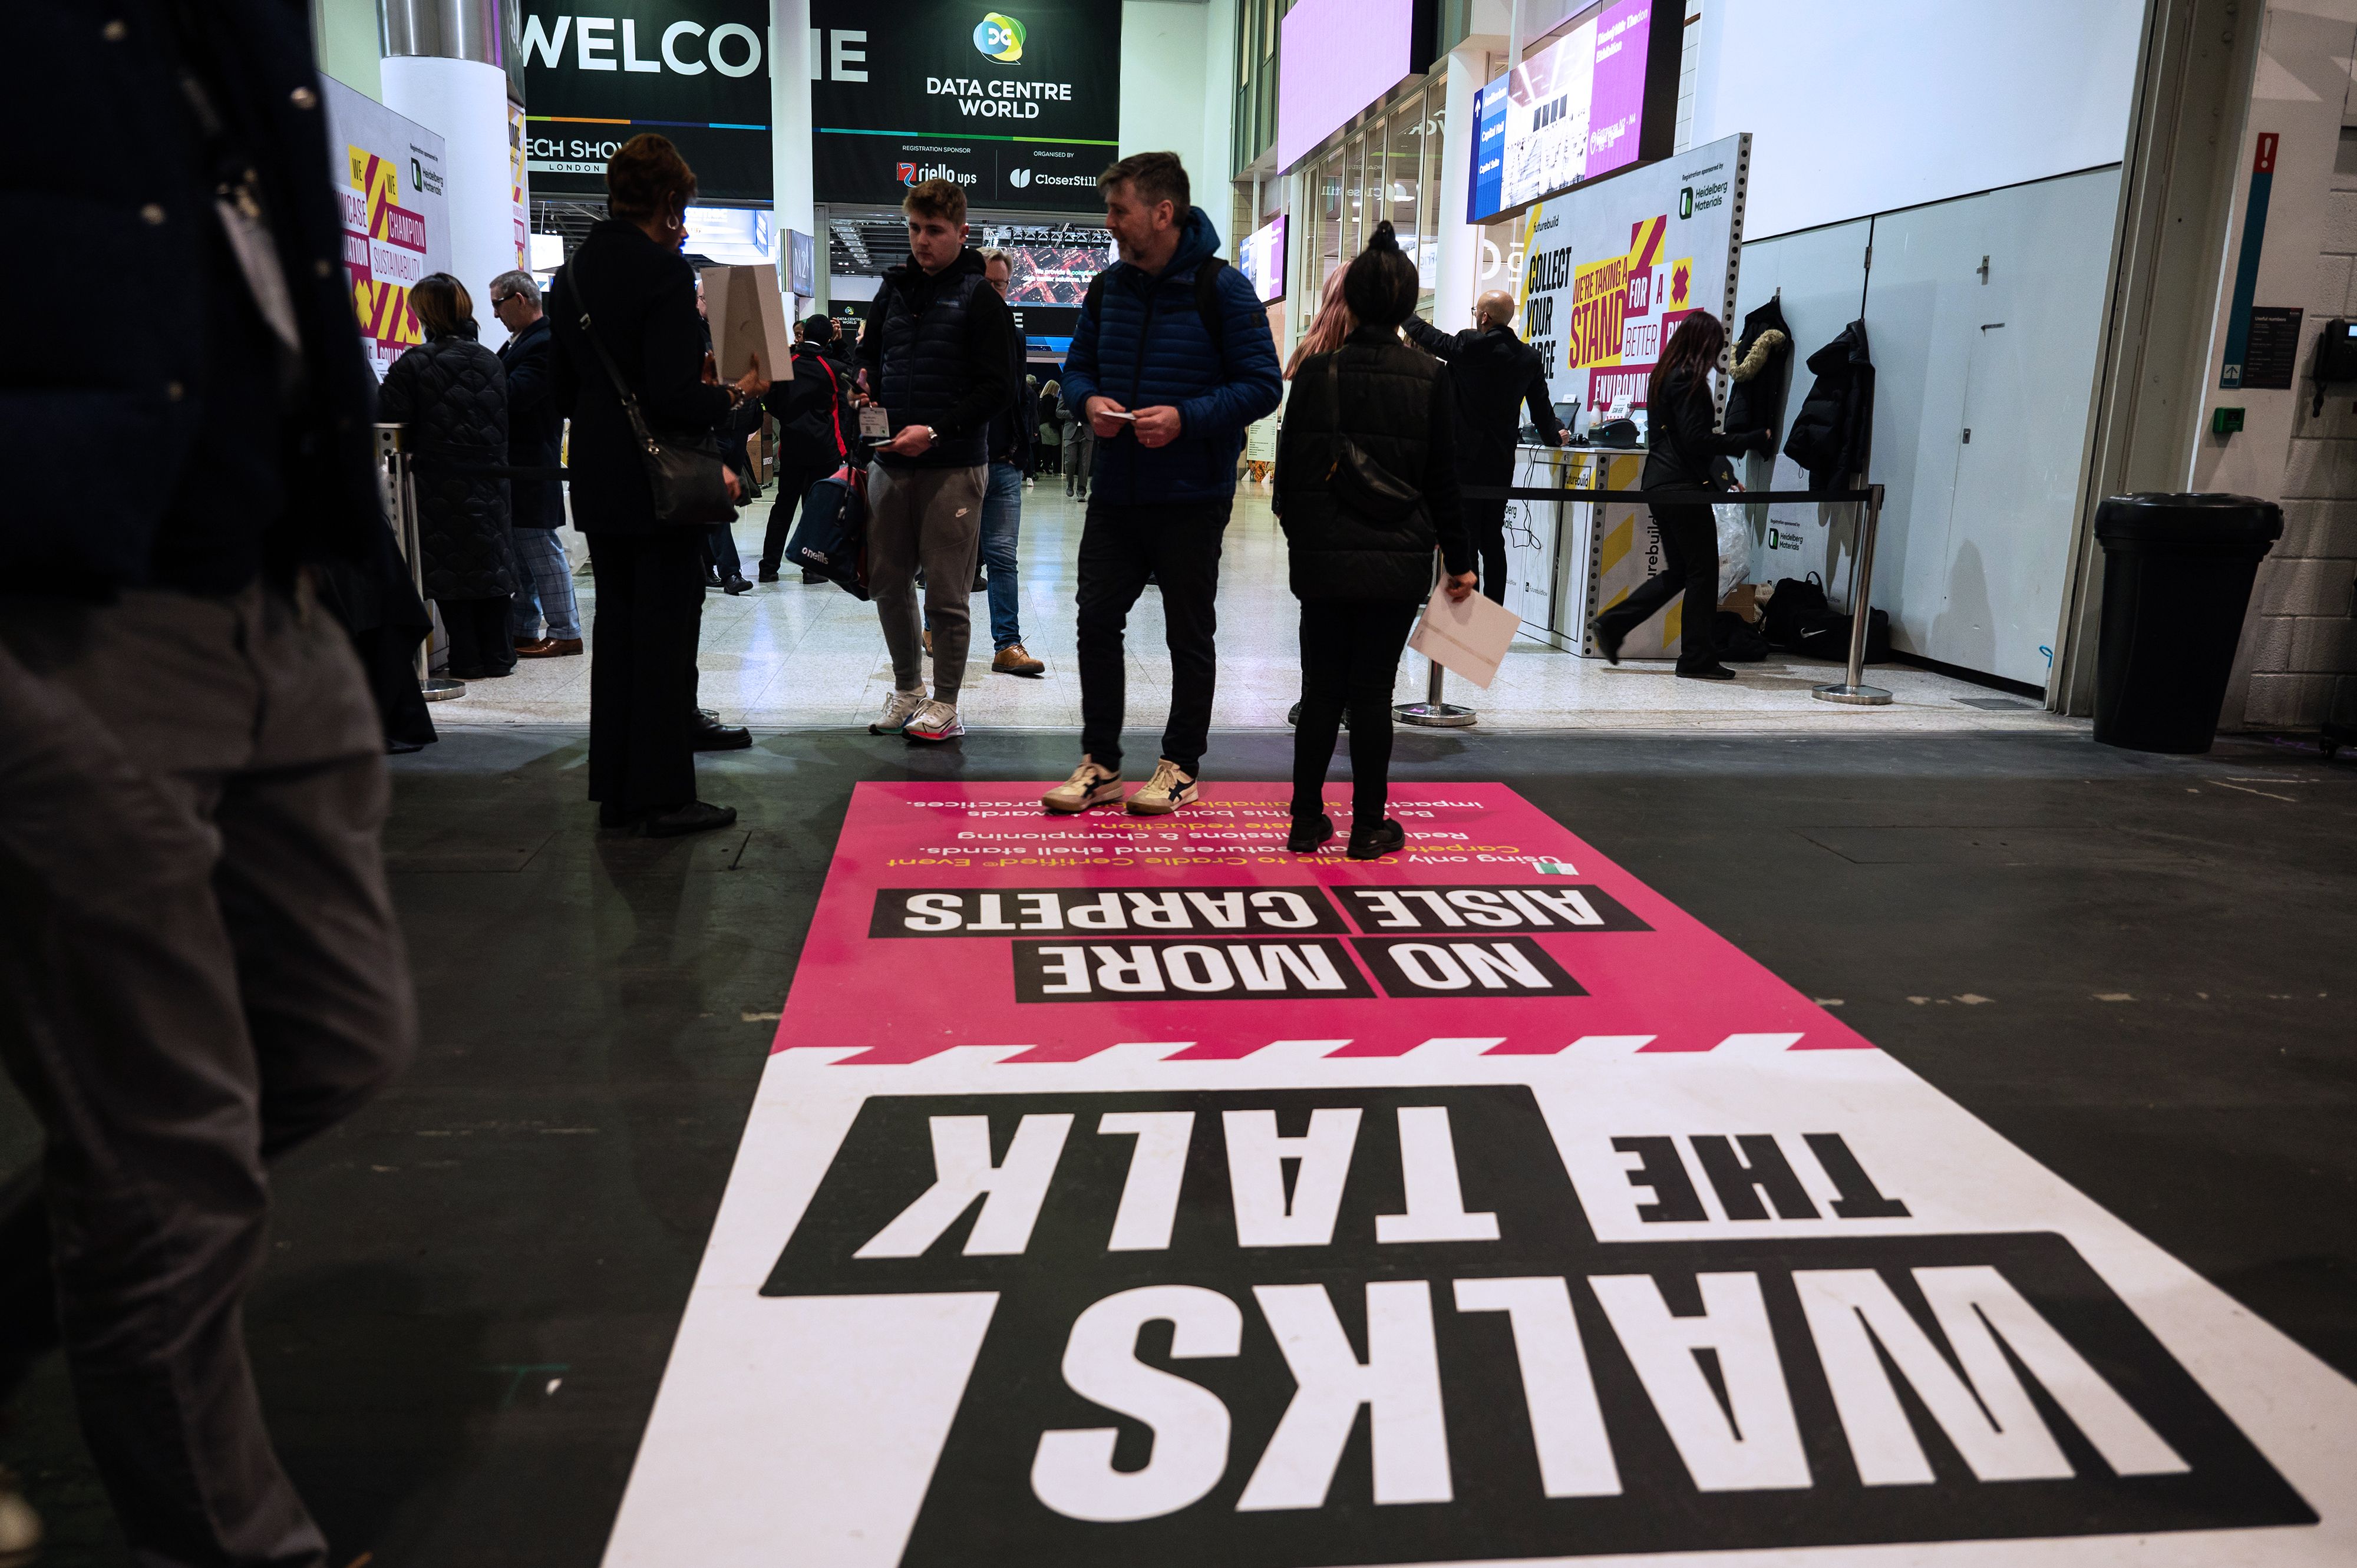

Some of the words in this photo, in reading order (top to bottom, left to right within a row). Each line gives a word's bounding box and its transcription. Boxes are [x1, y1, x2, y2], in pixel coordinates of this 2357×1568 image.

[522, 14, 869, 82] WELCOE
[927, 77, 983, 97] DATA
[988, 80, 1071, 101] CENTRE
[959, 99, 1039, 118] WORLD
[526, 138, 564, 157] ECH
[570, 140, 622, 159] SHO
[352, 157, 362, 181] WE
[422, 167, 443, 187] Heidelberg
[549, 164, 600, 172] LONDON
[919, 163, 955, 183] riello
[958, 173, 977, 187] ups
[1682, 171, 1701, 181] Registration
[1701, 163, 1718, 176] sponsored
[387, 173, 395, 195] WE
[423, 179, 441, 196] Materials
[1035, 174, 1097, 186] CloserStill
[1696, 181, 1728, 199] Heidelberg
[1695, 195, 1722, 212] Materials
[389, 211, 424, 247] CHAMPION
[1533, 214, 1559, 233] futurebuild
[374, 247, 420, 282] SUSTAINABILITY
[1529, 246, 1572, 295] COLLECT
[1573, 272, 1593, 305] WE'RE
[1595, 259, 1621, 298] TAKING
[1623, 256, 1628, 284] A
[1629, 276, 1648, 309] FOR
[1656, 273, 1663, 304] A
[1527, 296, 1553, 338] YOUR
[1569, 289, 1627, 369] STAND
[1625, 324, 1658, 357] BETTER
[1779, 541, 1800, 550] Materials
[1780, 532, 1803, 544] Heidelberg
[802, 547, 828, 565] oneills
[907, 800, 1042, 808] practices.
[958, 831, 1150, 841] championing
[919, 847, 1026, 856] stands.
[1038, 847, 1104, 856] shell
[1404, 844, 1520, 853] Carpets
[886, 859, 970, 867] Event
[1145, 857, 1247, 866] Cradle
[1408, 854, 1468, 864] only
[1476, 854, 1562, 864] Using
[903, 890, 1319, 932] CARPETS
[1354, 889, 1605, 926] AISLE
[1038, 945, 1348, 994] MORE
[1387, 943, 1553, 991] NO
[852, 1105, 1501, 1259] TALK
[1610, 1133, 1913, 1223] THE
[1031, 1265, 2192, 1521] WALKS
